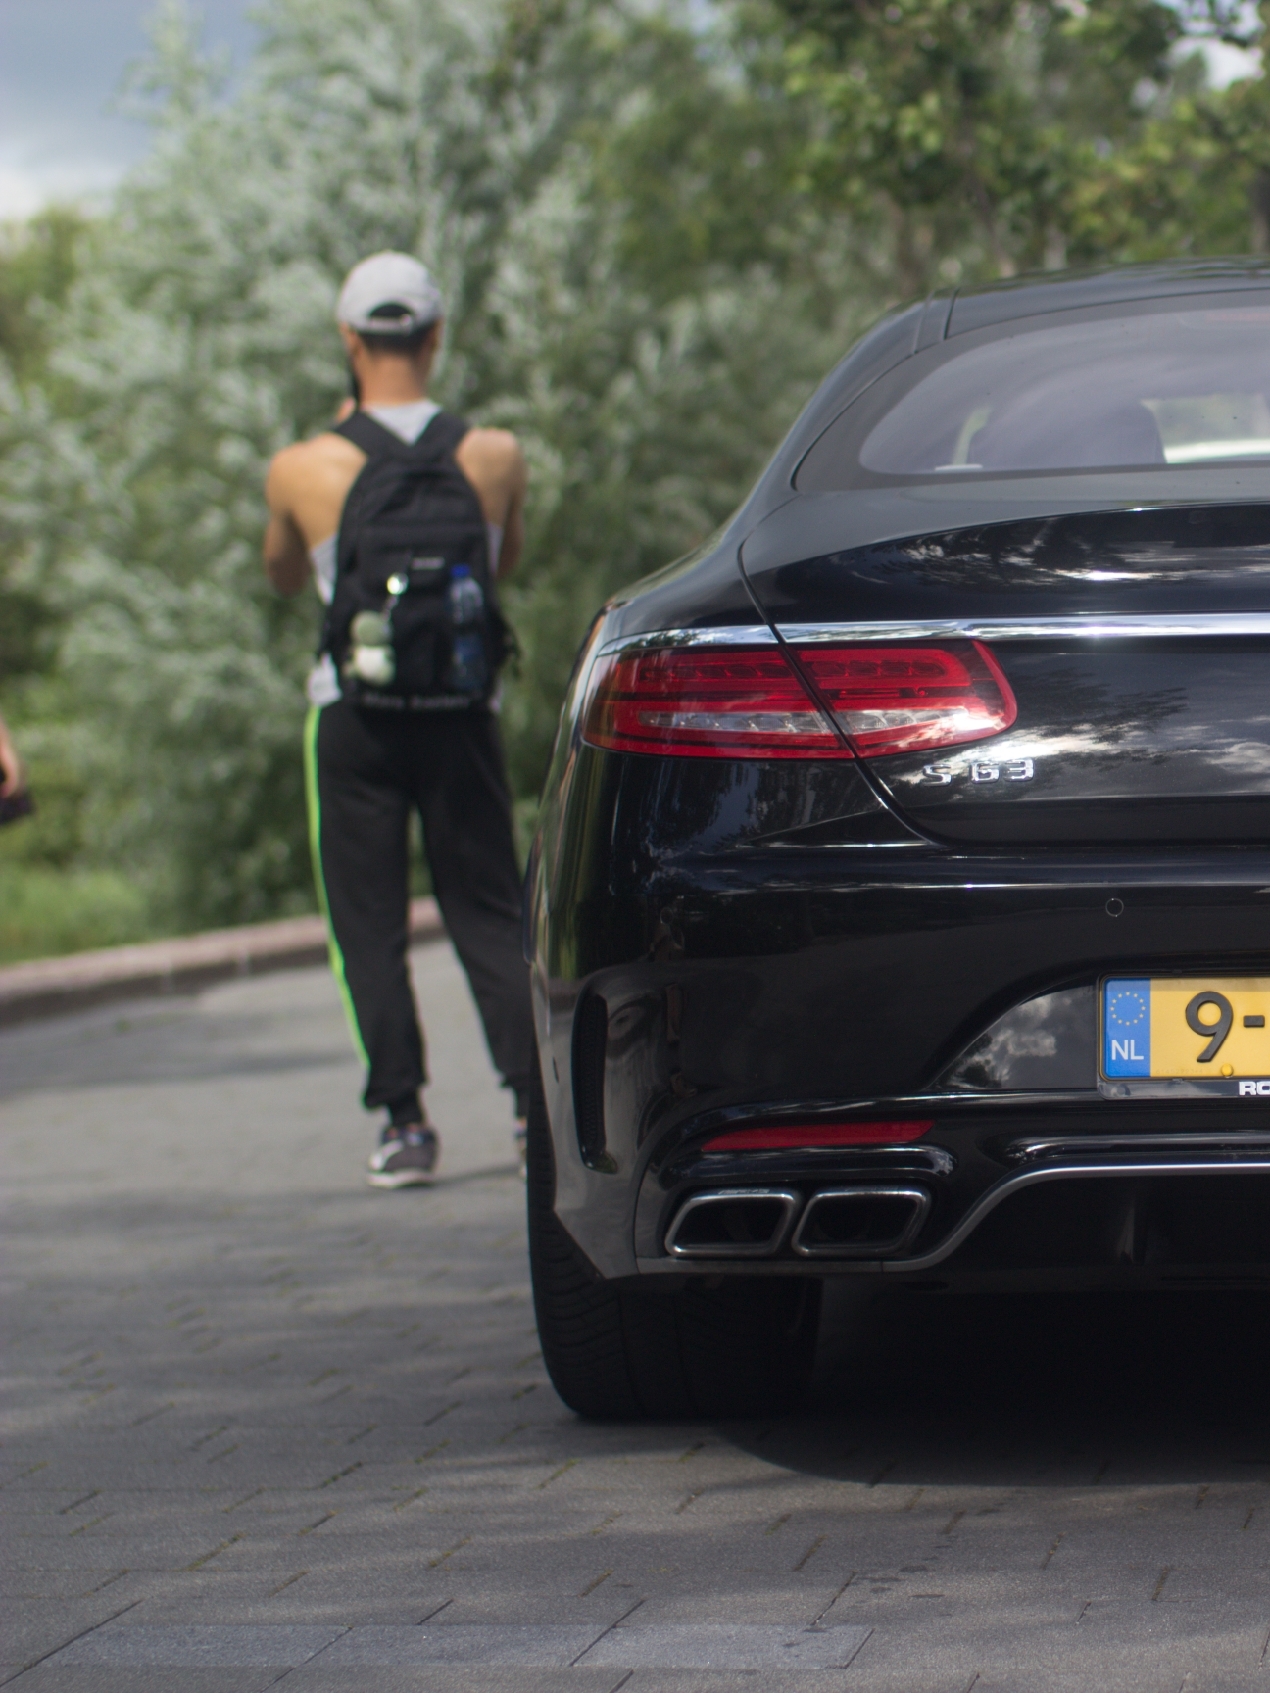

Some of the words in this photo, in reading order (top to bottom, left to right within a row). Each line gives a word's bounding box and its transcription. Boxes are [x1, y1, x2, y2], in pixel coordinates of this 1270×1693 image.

[922, 764, 952, 787] S
[970, 759, 1034, 783] 63
[1110, 1039, 1145, 1061] NL
